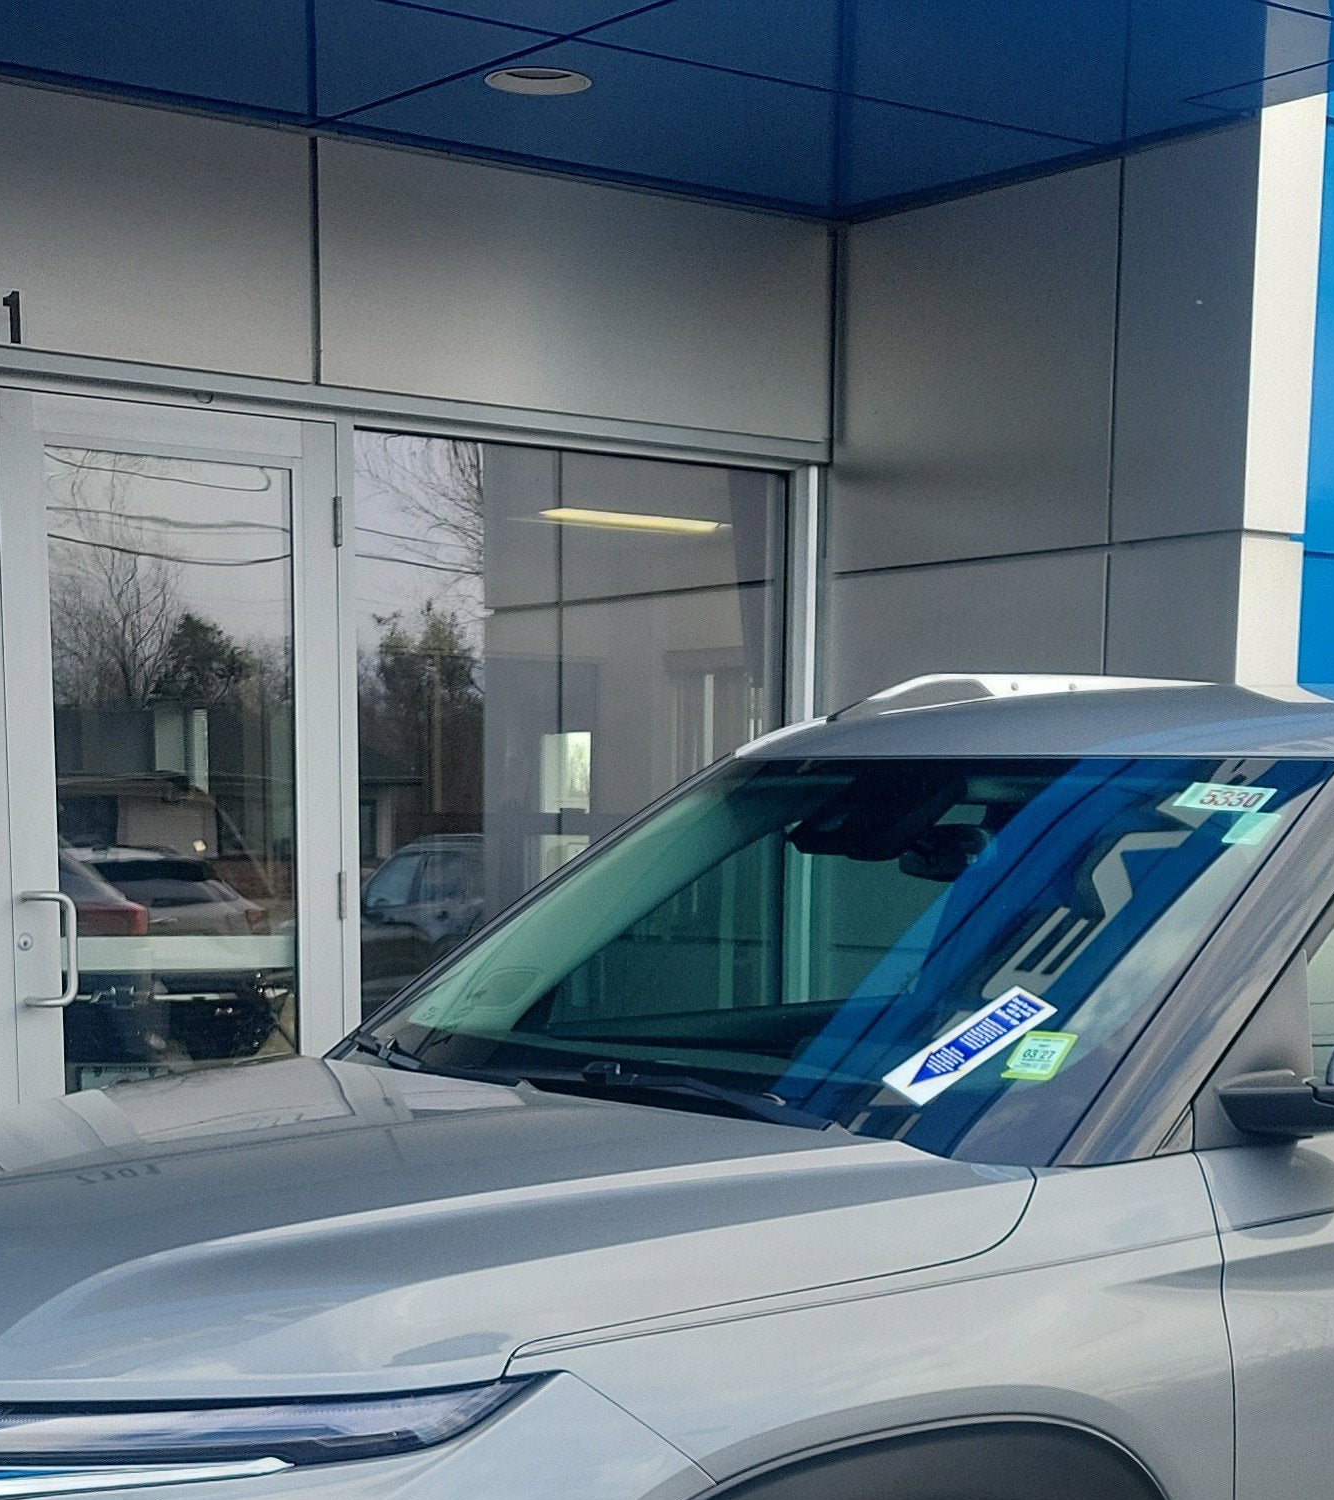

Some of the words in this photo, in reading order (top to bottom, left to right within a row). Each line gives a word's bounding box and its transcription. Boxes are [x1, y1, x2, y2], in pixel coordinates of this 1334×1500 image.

[1199, 788, 1266, 808] 5330
[1022, 1048, 1039, 1059] 03
[1039, 1050, 1057, 1060] 27
